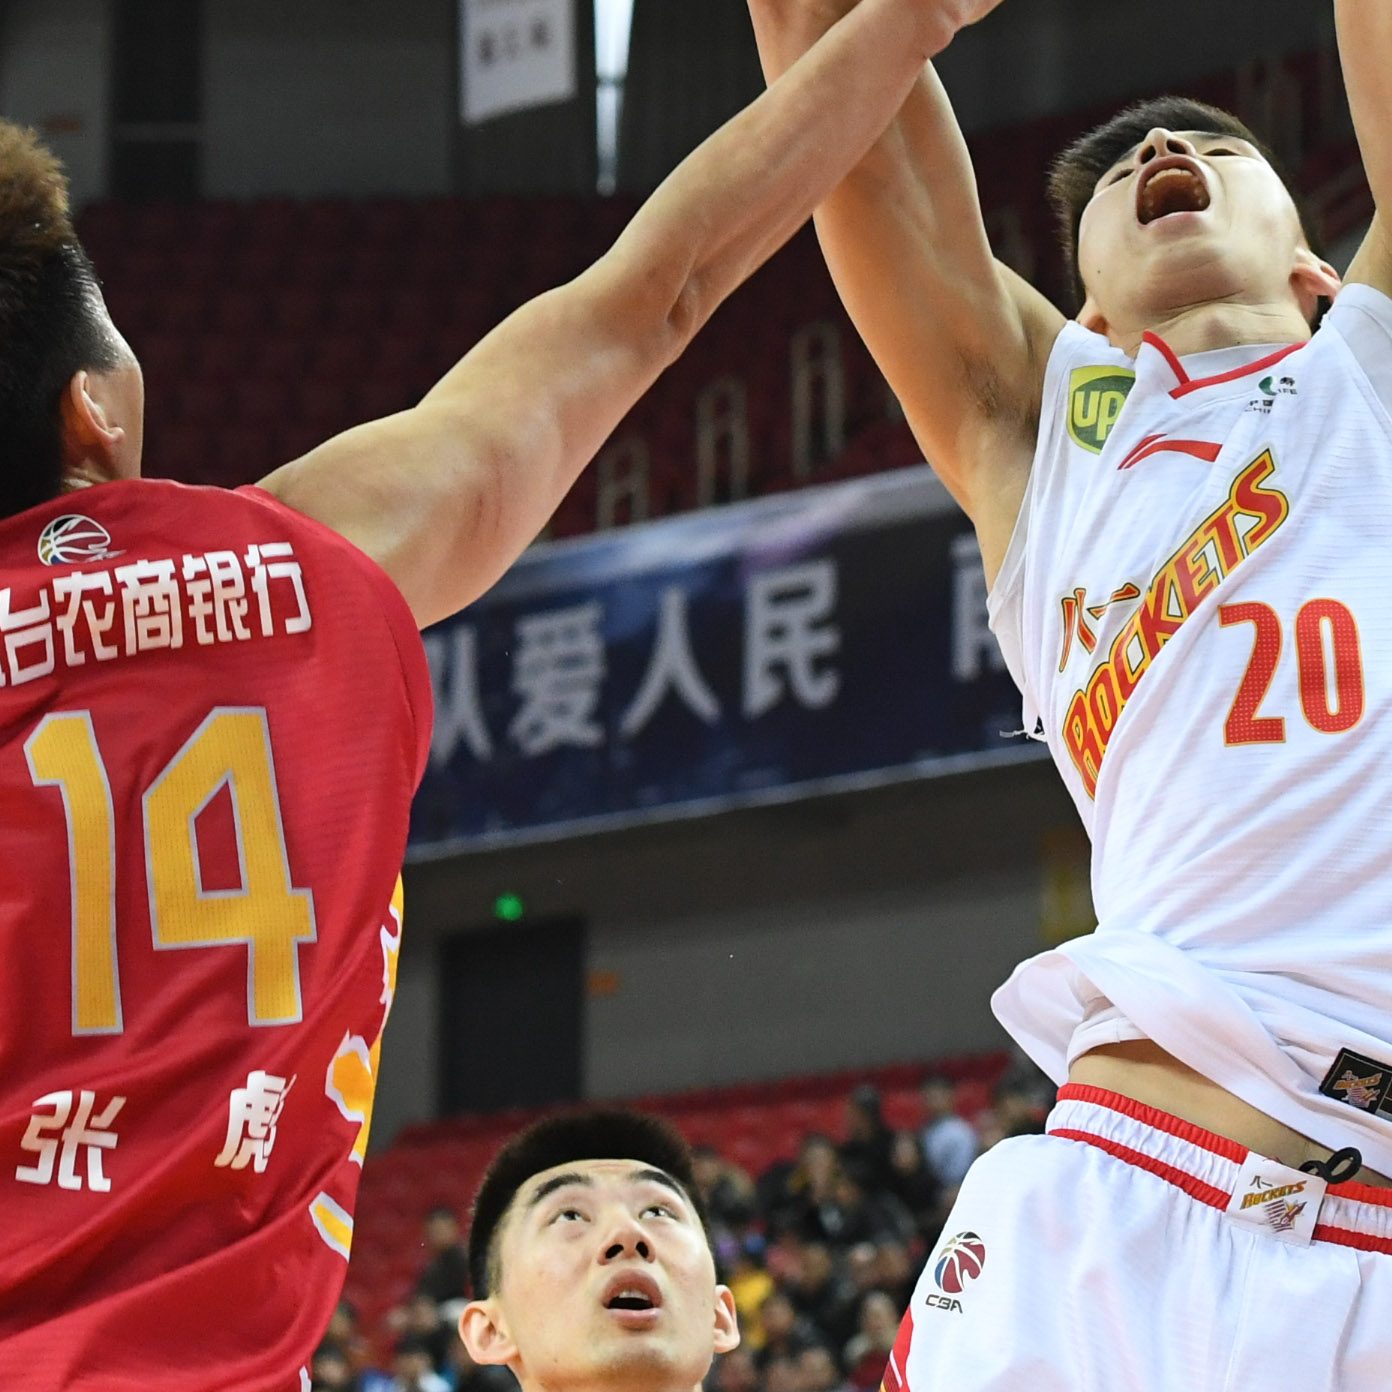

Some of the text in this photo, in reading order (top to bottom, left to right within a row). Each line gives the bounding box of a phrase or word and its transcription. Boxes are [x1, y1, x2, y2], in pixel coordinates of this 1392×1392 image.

[1073, 390, 1126, 441] up
[1061, 447, 1290, 802] ROCKETS
[1217, 597, 1366, 748] 20
[23, 706, 318, 1037] 14
[924, 1293, 964, 1314] CBA
